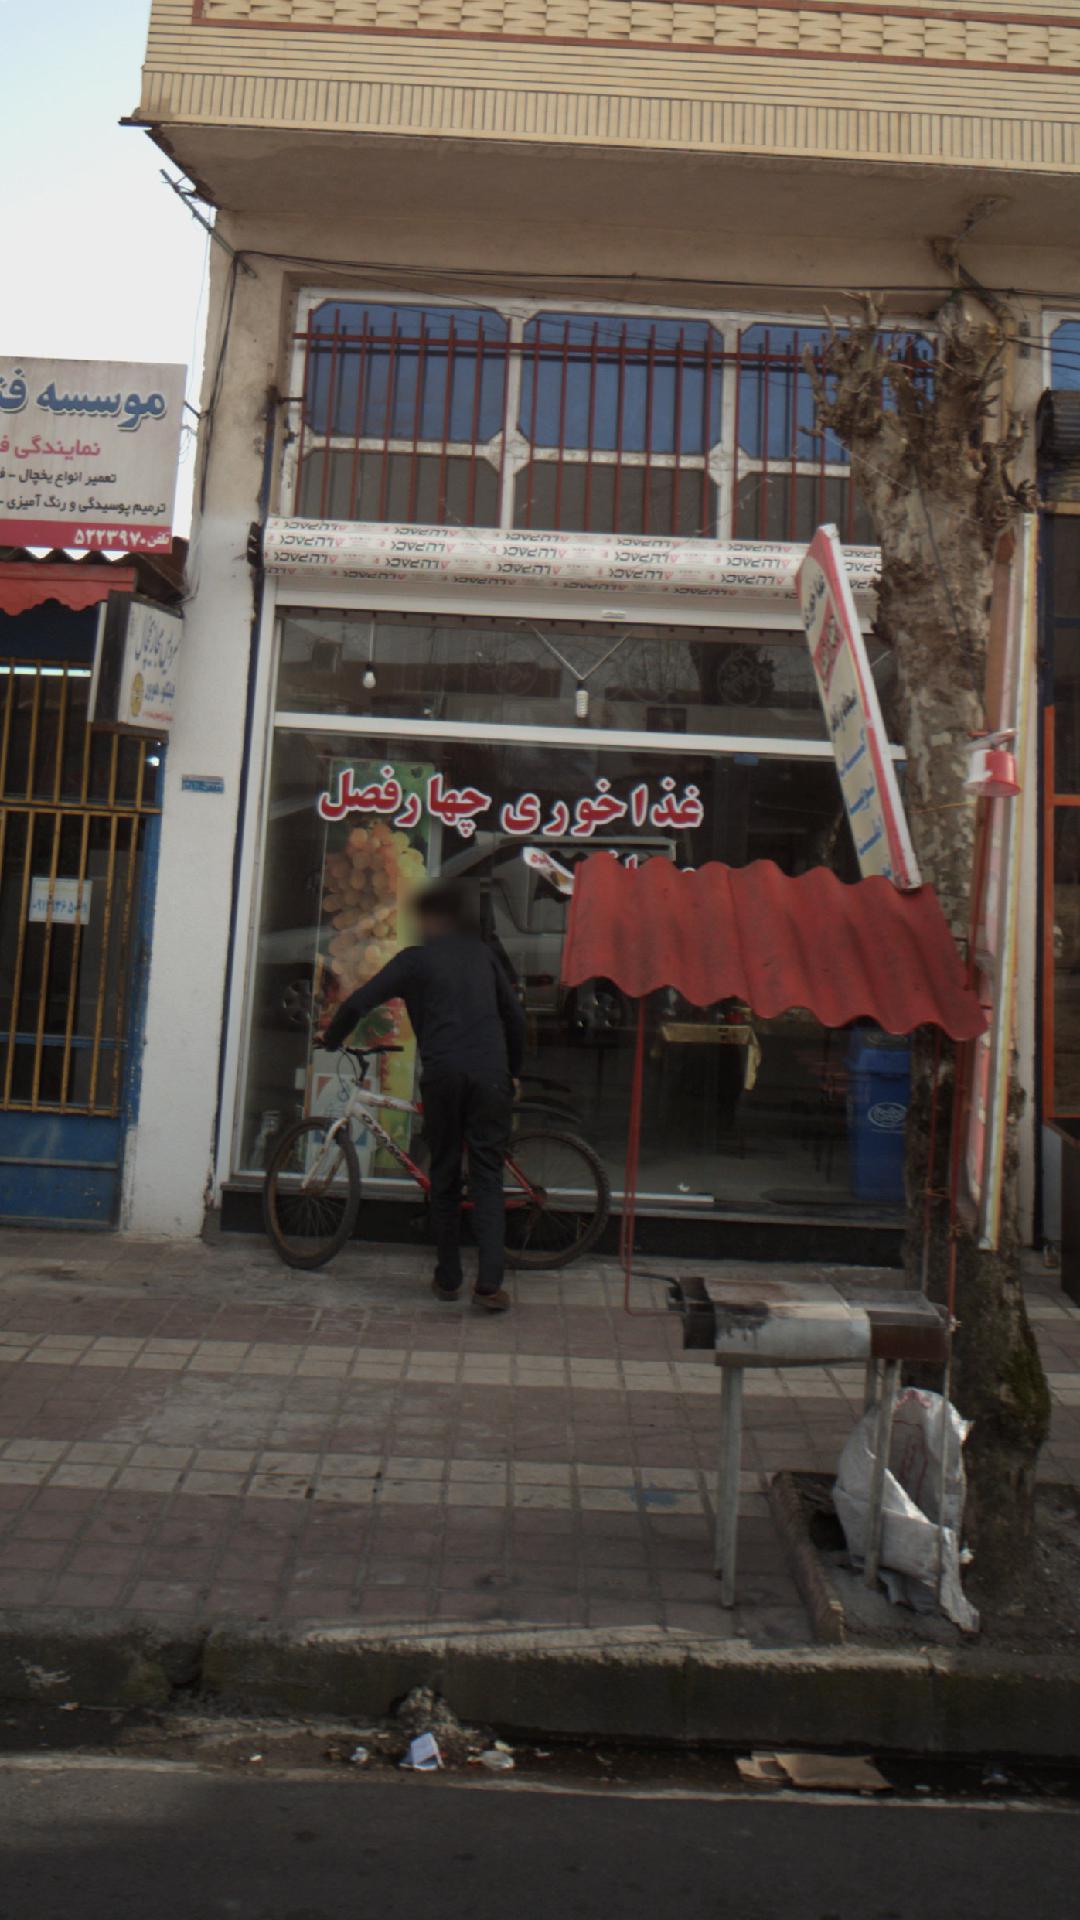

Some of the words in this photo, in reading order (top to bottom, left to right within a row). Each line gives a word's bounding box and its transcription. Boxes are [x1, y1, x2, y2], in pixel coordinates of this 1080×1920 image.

[36, 380, 166, 431] موسسه
[14, 434, 101, 460] نمایندگی
[18, 469, 53, 486] یخچال
[55, 471, 83, 488] انواع
[84, 473, 117, 486] تعمیر
[78, 496, 130, 517] پوسیدگی
[133, 502, 166, 516] ترمیم
